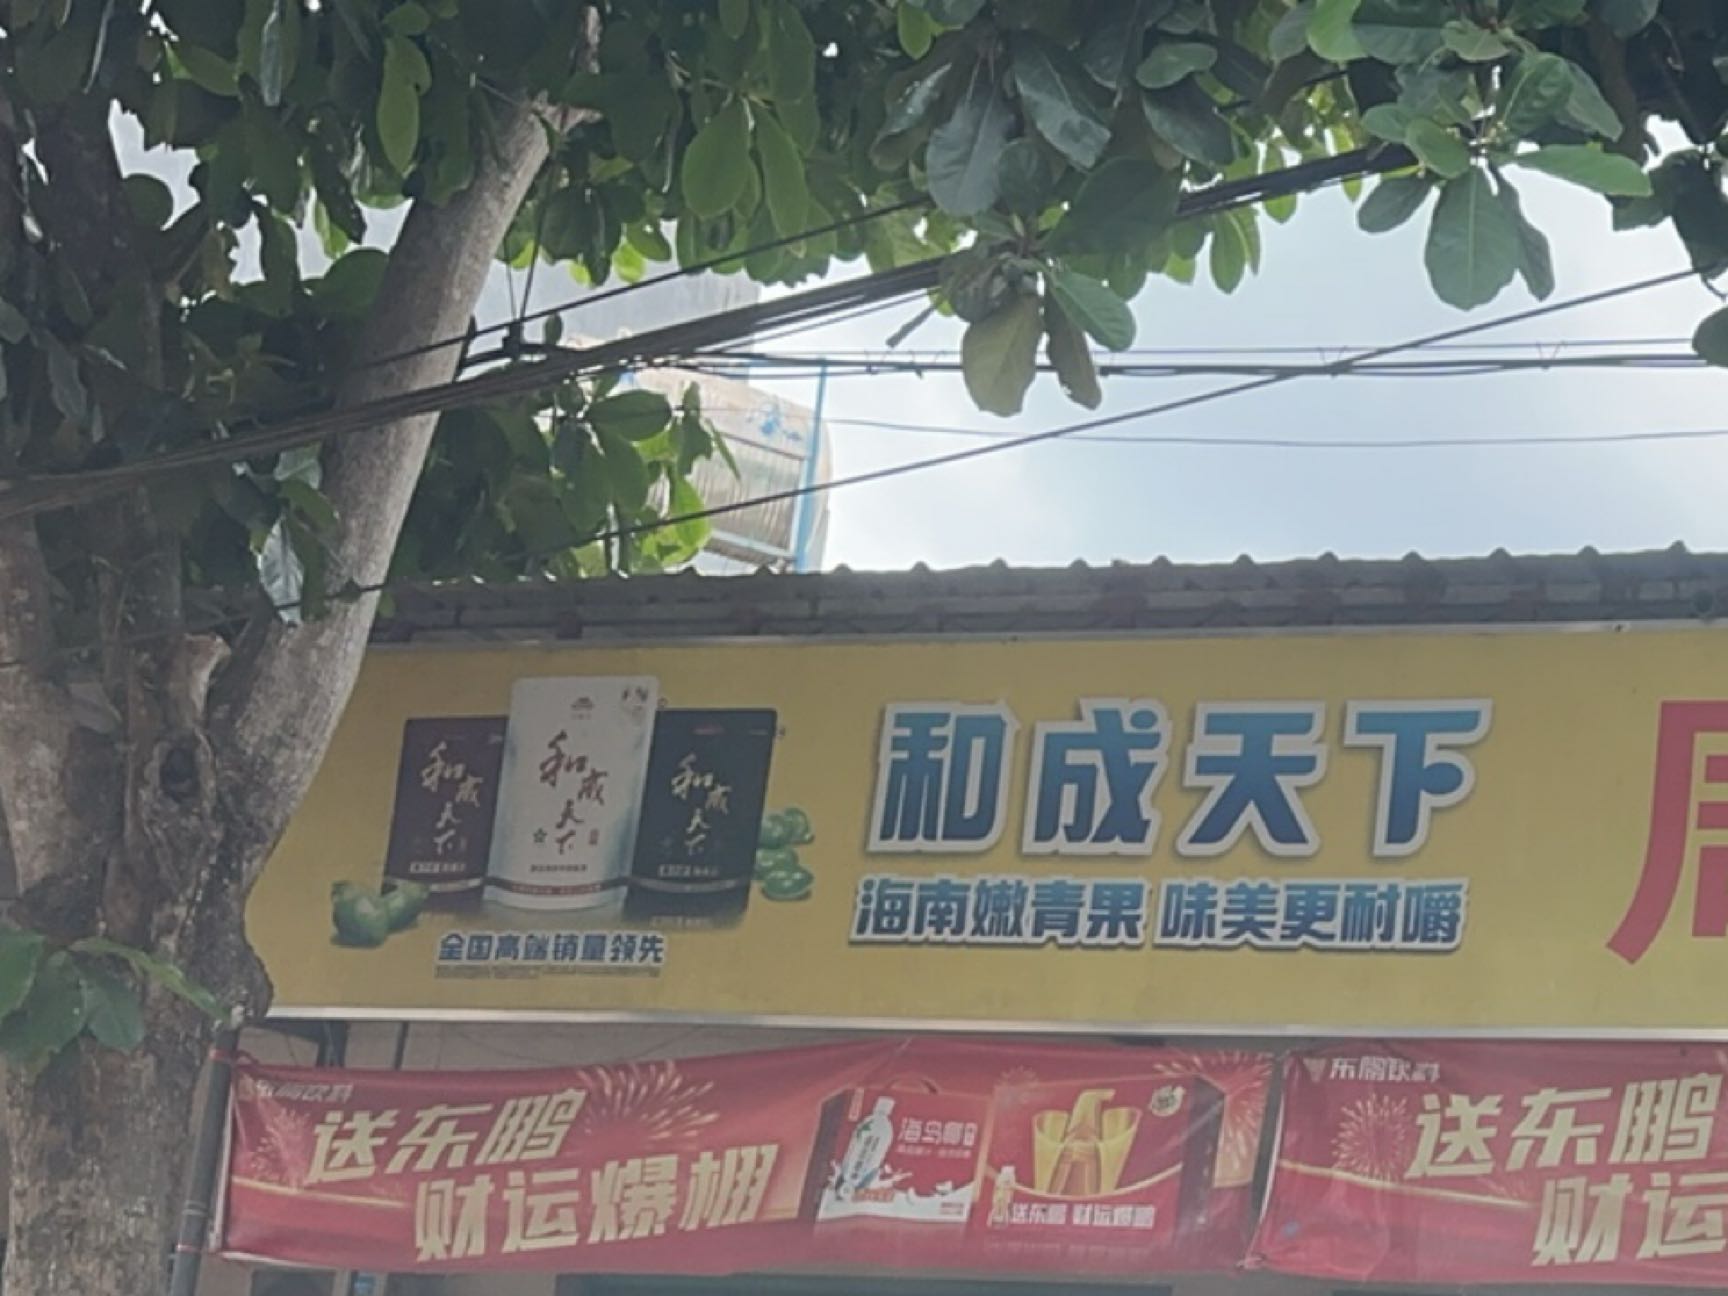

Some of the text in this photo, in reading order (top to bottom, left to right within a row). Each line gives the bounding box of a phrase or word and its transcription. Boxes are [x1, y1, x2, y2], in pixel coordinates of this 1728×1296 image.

[870, 703, 1487, 852] 和成天下
[438, 932, 666, 963] 全国高端销量领先
[853, 877, 1466, 946] 海南嫩青果 味美更耐嚼
[305, 1087, 588, 1185] 送东鹏
[1404, 1073, 1723, 1180] 送东鹏
[415, 1143, 780, 1264] 财运爆棚
